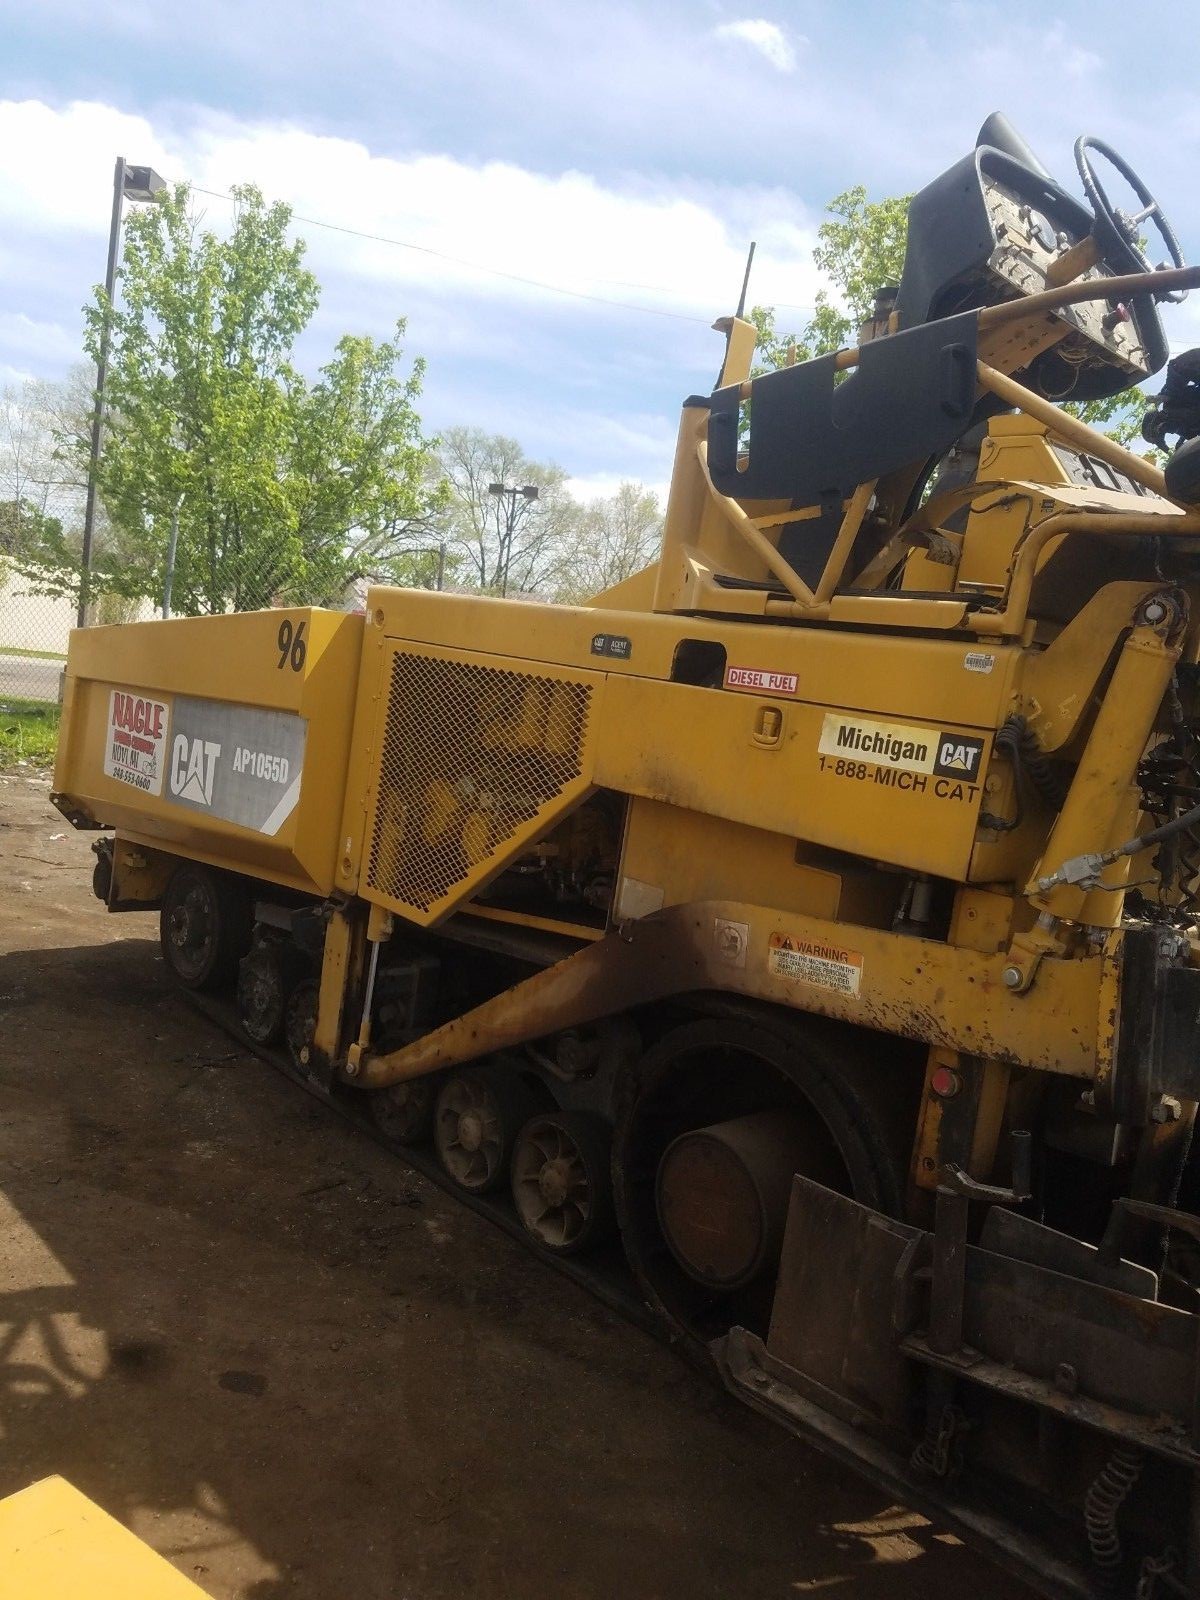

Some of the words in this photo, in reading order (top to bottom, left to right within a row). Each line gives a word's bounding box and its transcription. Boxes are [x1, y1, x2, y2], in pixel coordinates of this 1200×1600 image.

[277, 619, 306, 673] 96
[730, 669, 764, 687] DIESEL
[768, 674, 794, 690] FUEL
[112, 692, 165, 740] NAGLE
[171, 733, 222, 806] CAT
[232, 747, 289, 784] AP1055D
[837, 725, 928, 762] Michigan
[939, 742, 978, 770] CAT
[818, 756, 928, 793] 1-888-MICH
[934, 779, 980, 803] CAT
[796, 941, 848, 963] WARNING
